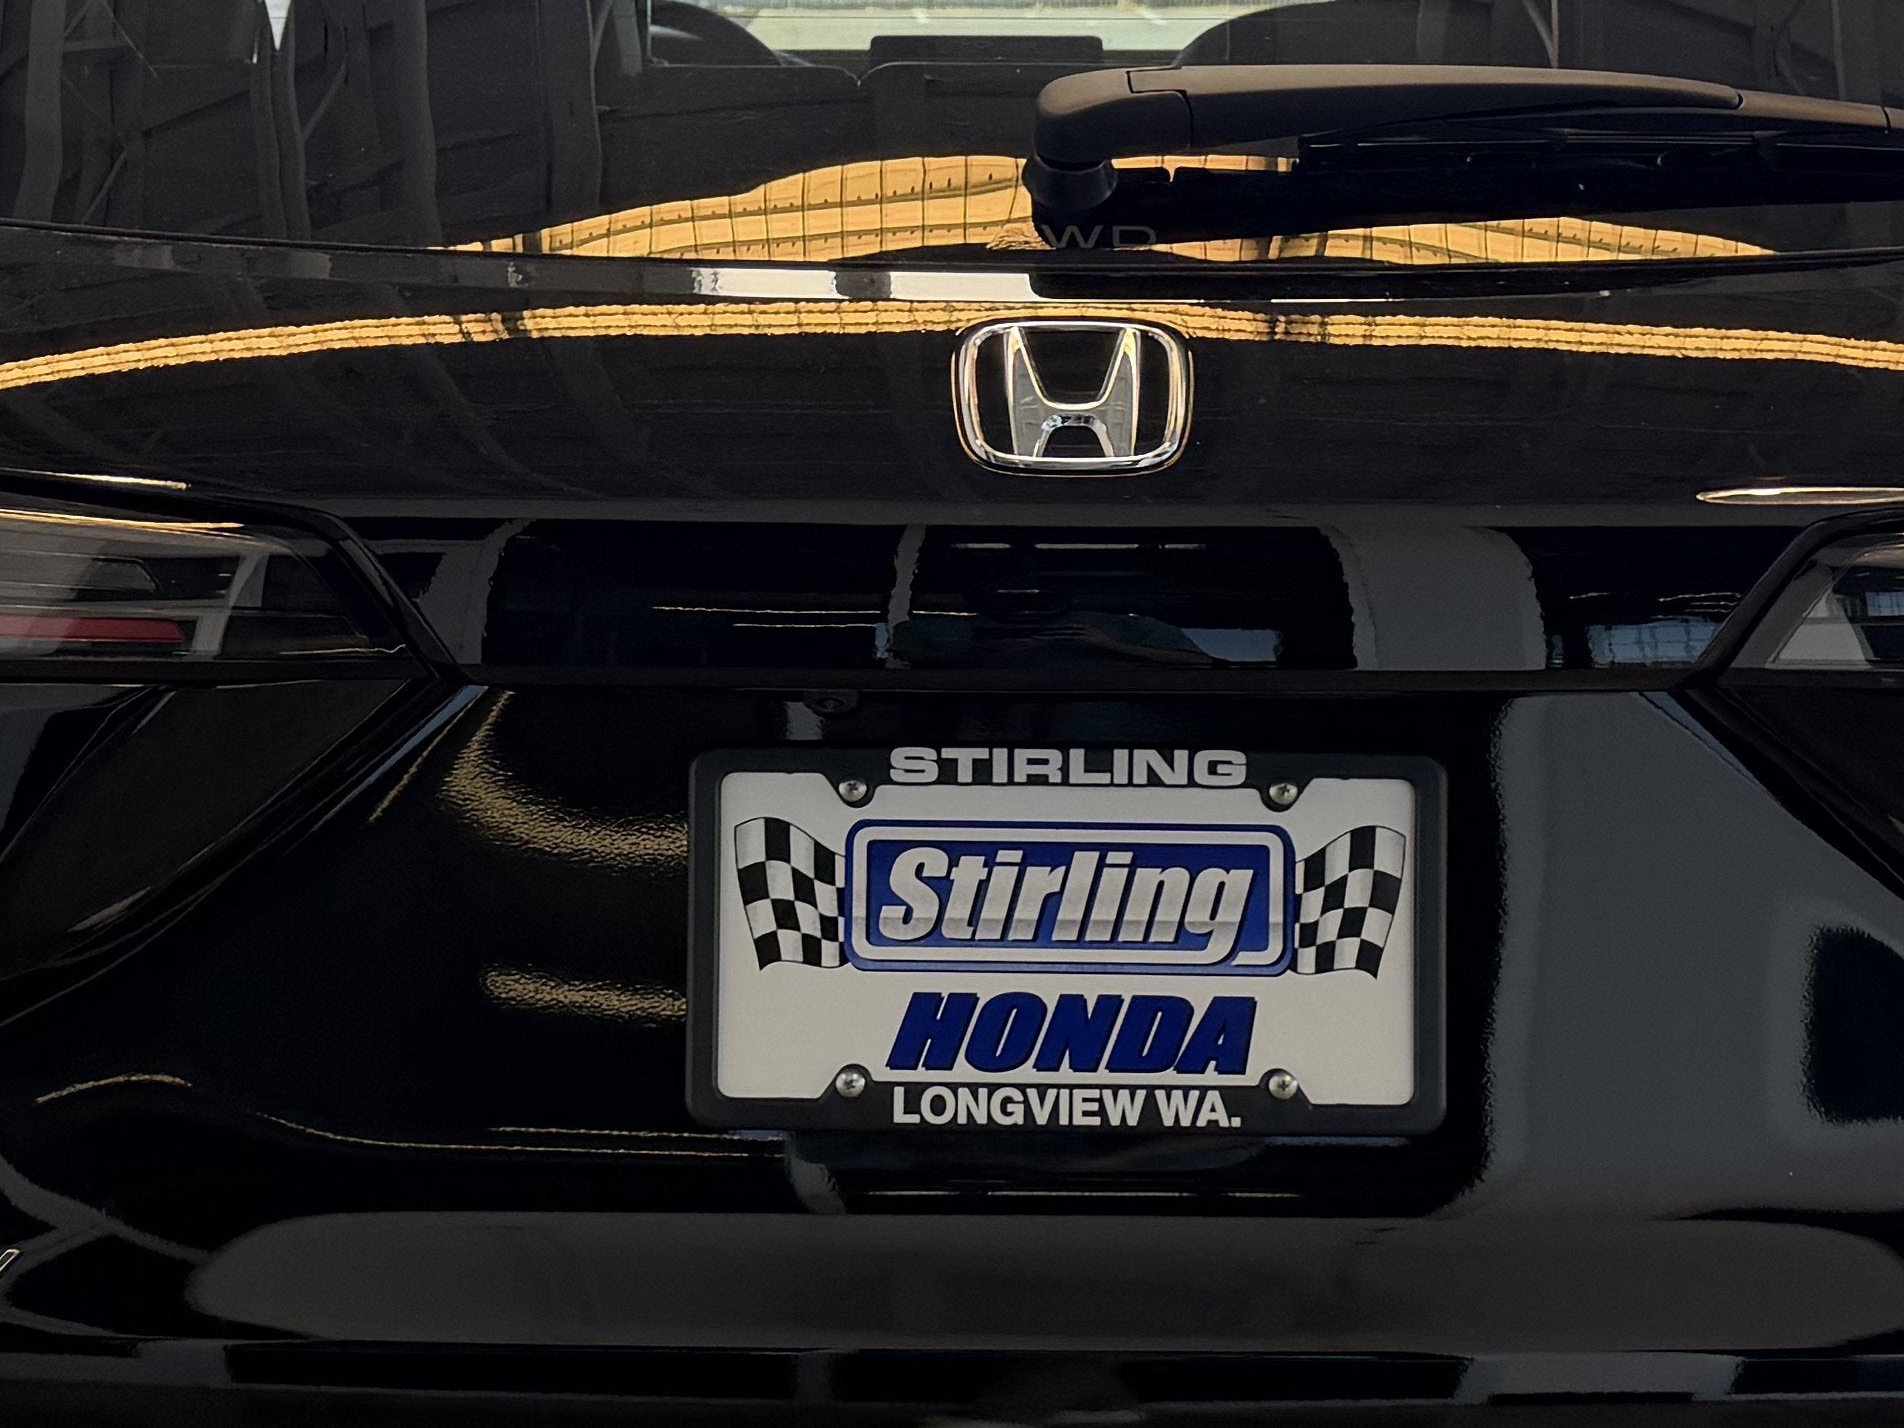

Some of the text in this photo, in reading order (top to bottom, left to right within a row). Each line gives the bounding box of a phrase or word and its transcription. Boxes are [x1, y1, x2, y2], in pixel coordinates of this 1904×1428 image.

[1039, 224, 1158, 249] WD
[889, 746, 1247, 786] STIRLING
[877, 846, 1255, 965] Stirling
[885, 991, 1258, 1075] HONDA
[892, 1084, 1242, 1128] LONGVIEW WA.
